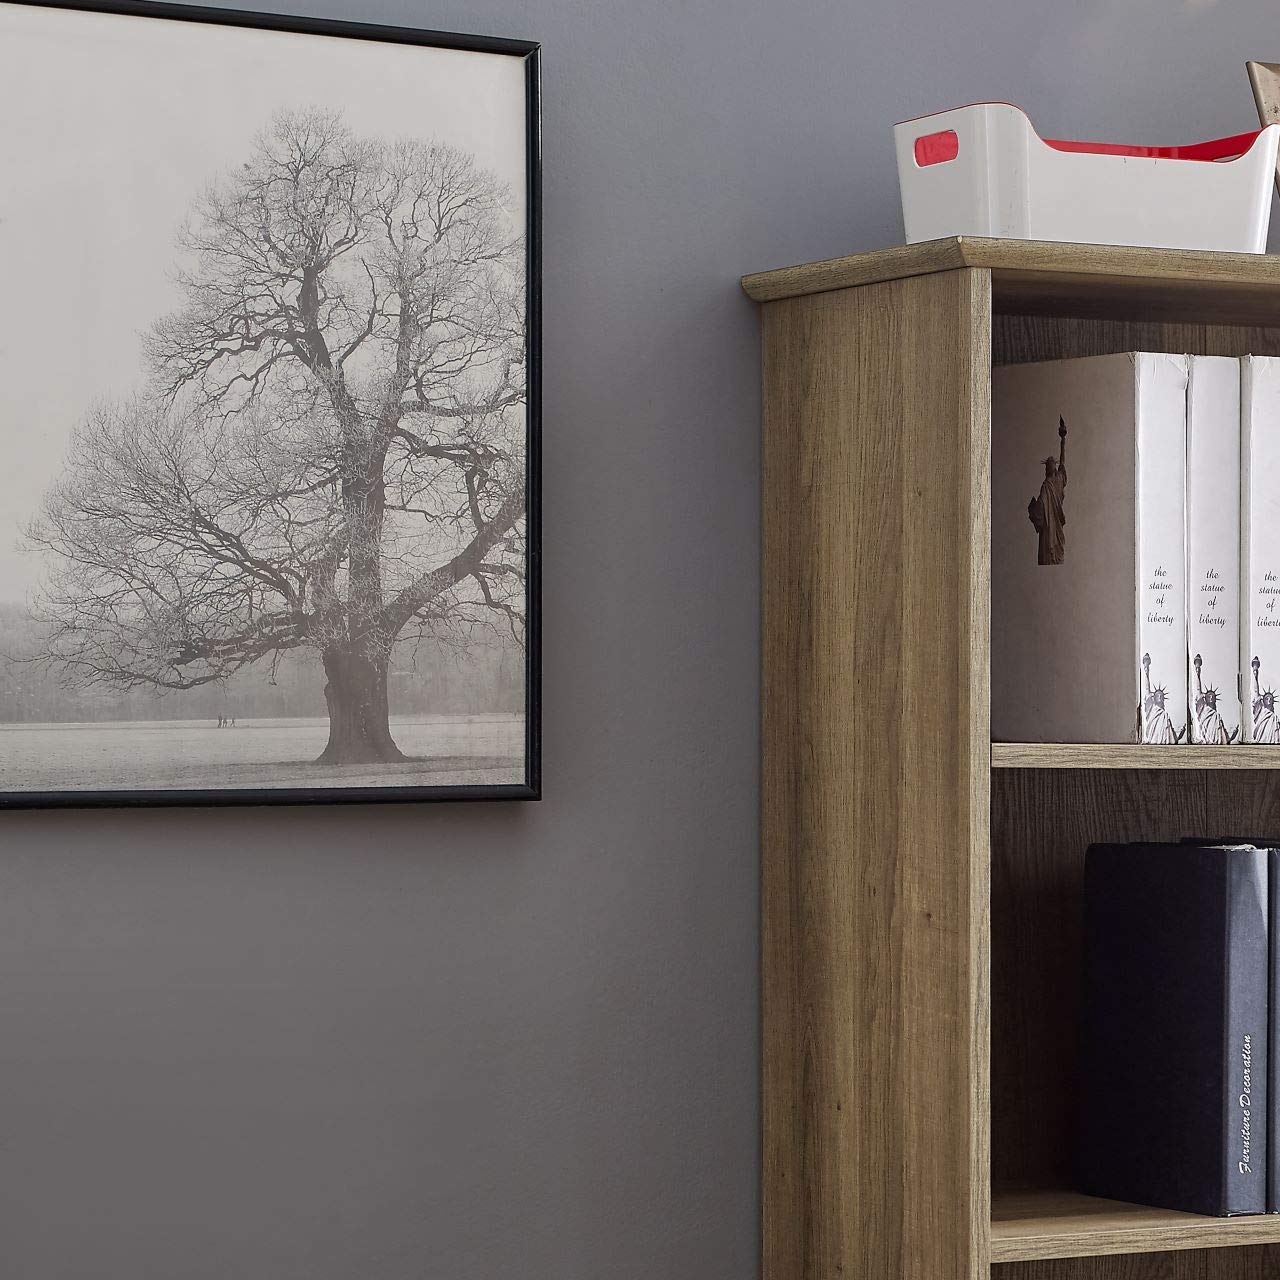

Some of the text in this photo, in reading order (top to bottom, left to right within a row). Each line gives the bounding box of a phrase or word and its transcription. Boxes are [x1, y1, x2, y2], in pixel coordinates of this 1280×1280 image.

[1154, 565, 1167, 577] the
[1206, 568, 1219, 579] the
[1264, 570, 1278, 582] the
[1148, 582, 1173, 590] statue
[1200, 584, 1226, 592] statue
[1155, 593, 1165, 608] of
[1207, 595, 1218, 610] of
[1265, 598, 1275, 613] of
[1147, 612, 1174, 627] liberty
[1199, 613, 1226, 628] liberty
[1238, 1034, 1252, 1174] Furniture Decoration
